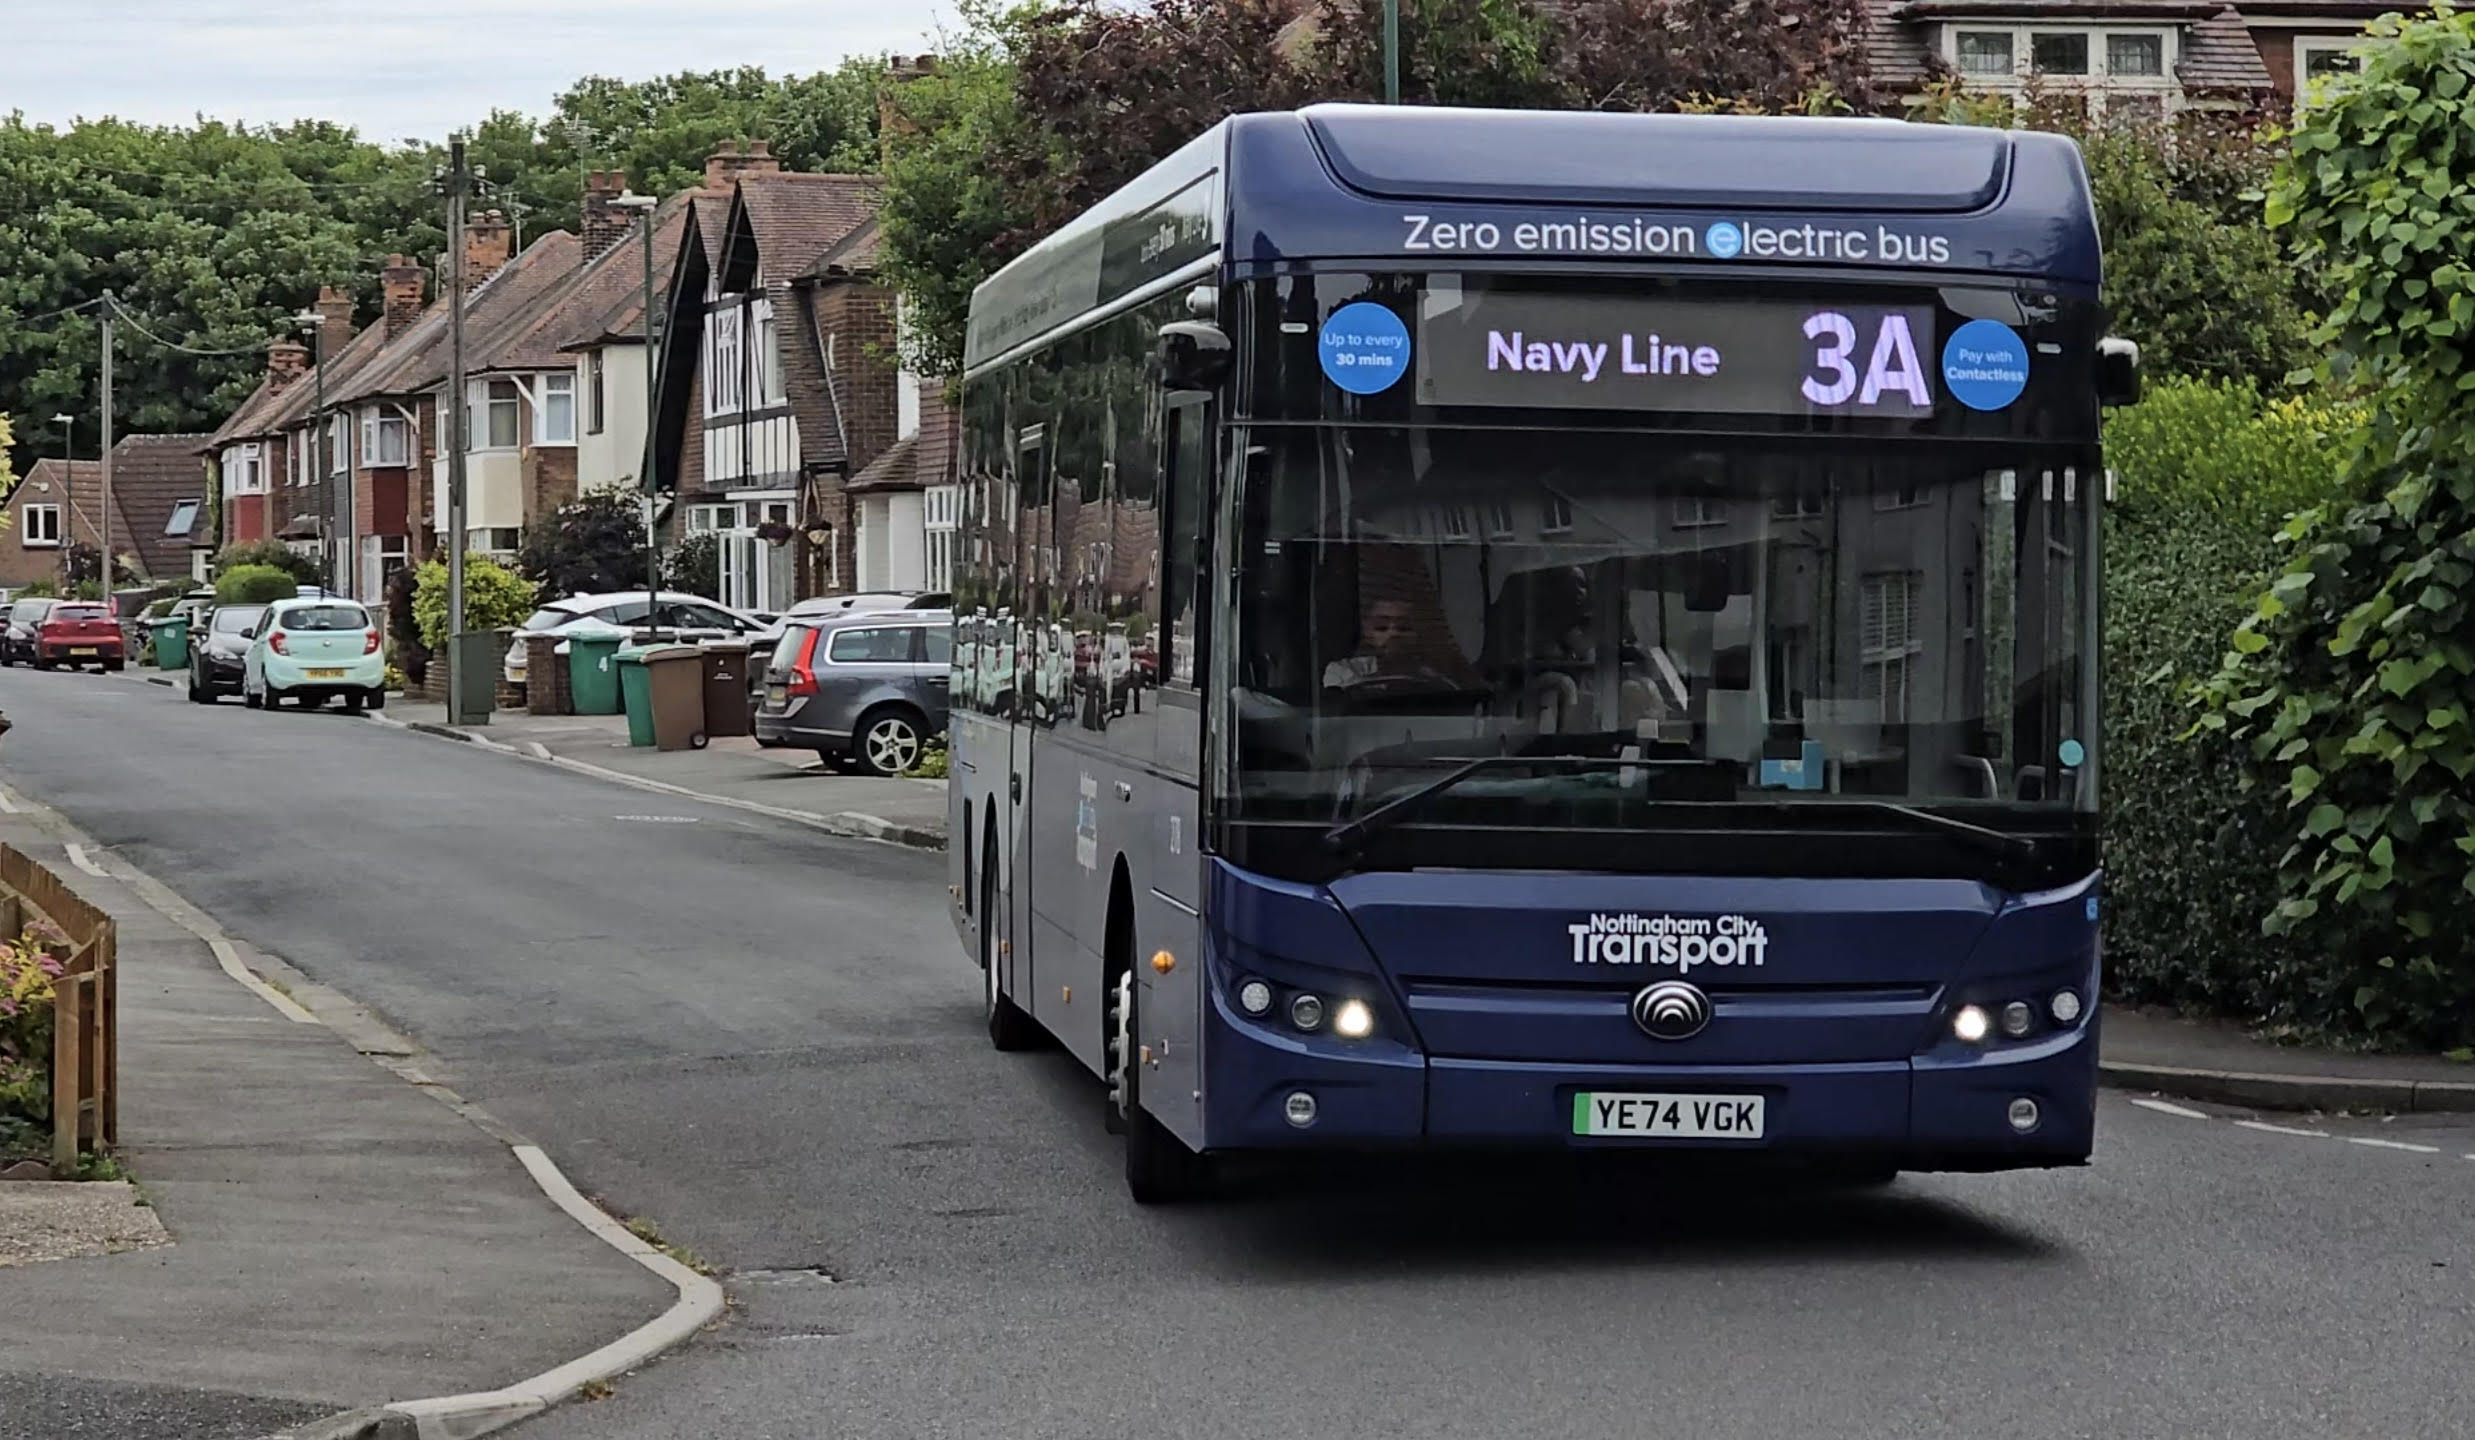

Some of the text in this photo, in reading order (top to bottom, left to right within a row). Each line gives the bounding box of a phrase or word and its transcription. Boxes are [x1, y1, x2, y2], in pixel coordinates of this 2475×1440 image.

[1403, 214, 1950, 262] Zero emission electric bus
[1324, 333, 1403, 349] Up to every
[1336, 352, 1393, 366] 30 mins
[1487, 331, 1721, 382] Navy Line
[1801, 311, 1931, 406] 3A
[1959, 348, 2014, 364] Pay with
[1947, 366, 2025, 382] Contactless
[1590, 913, 1758, 939] Nottingham City
[1568, 924, 1768, 974] Transport
[1597, 1099, 1755, 1131] YE74 VGK
